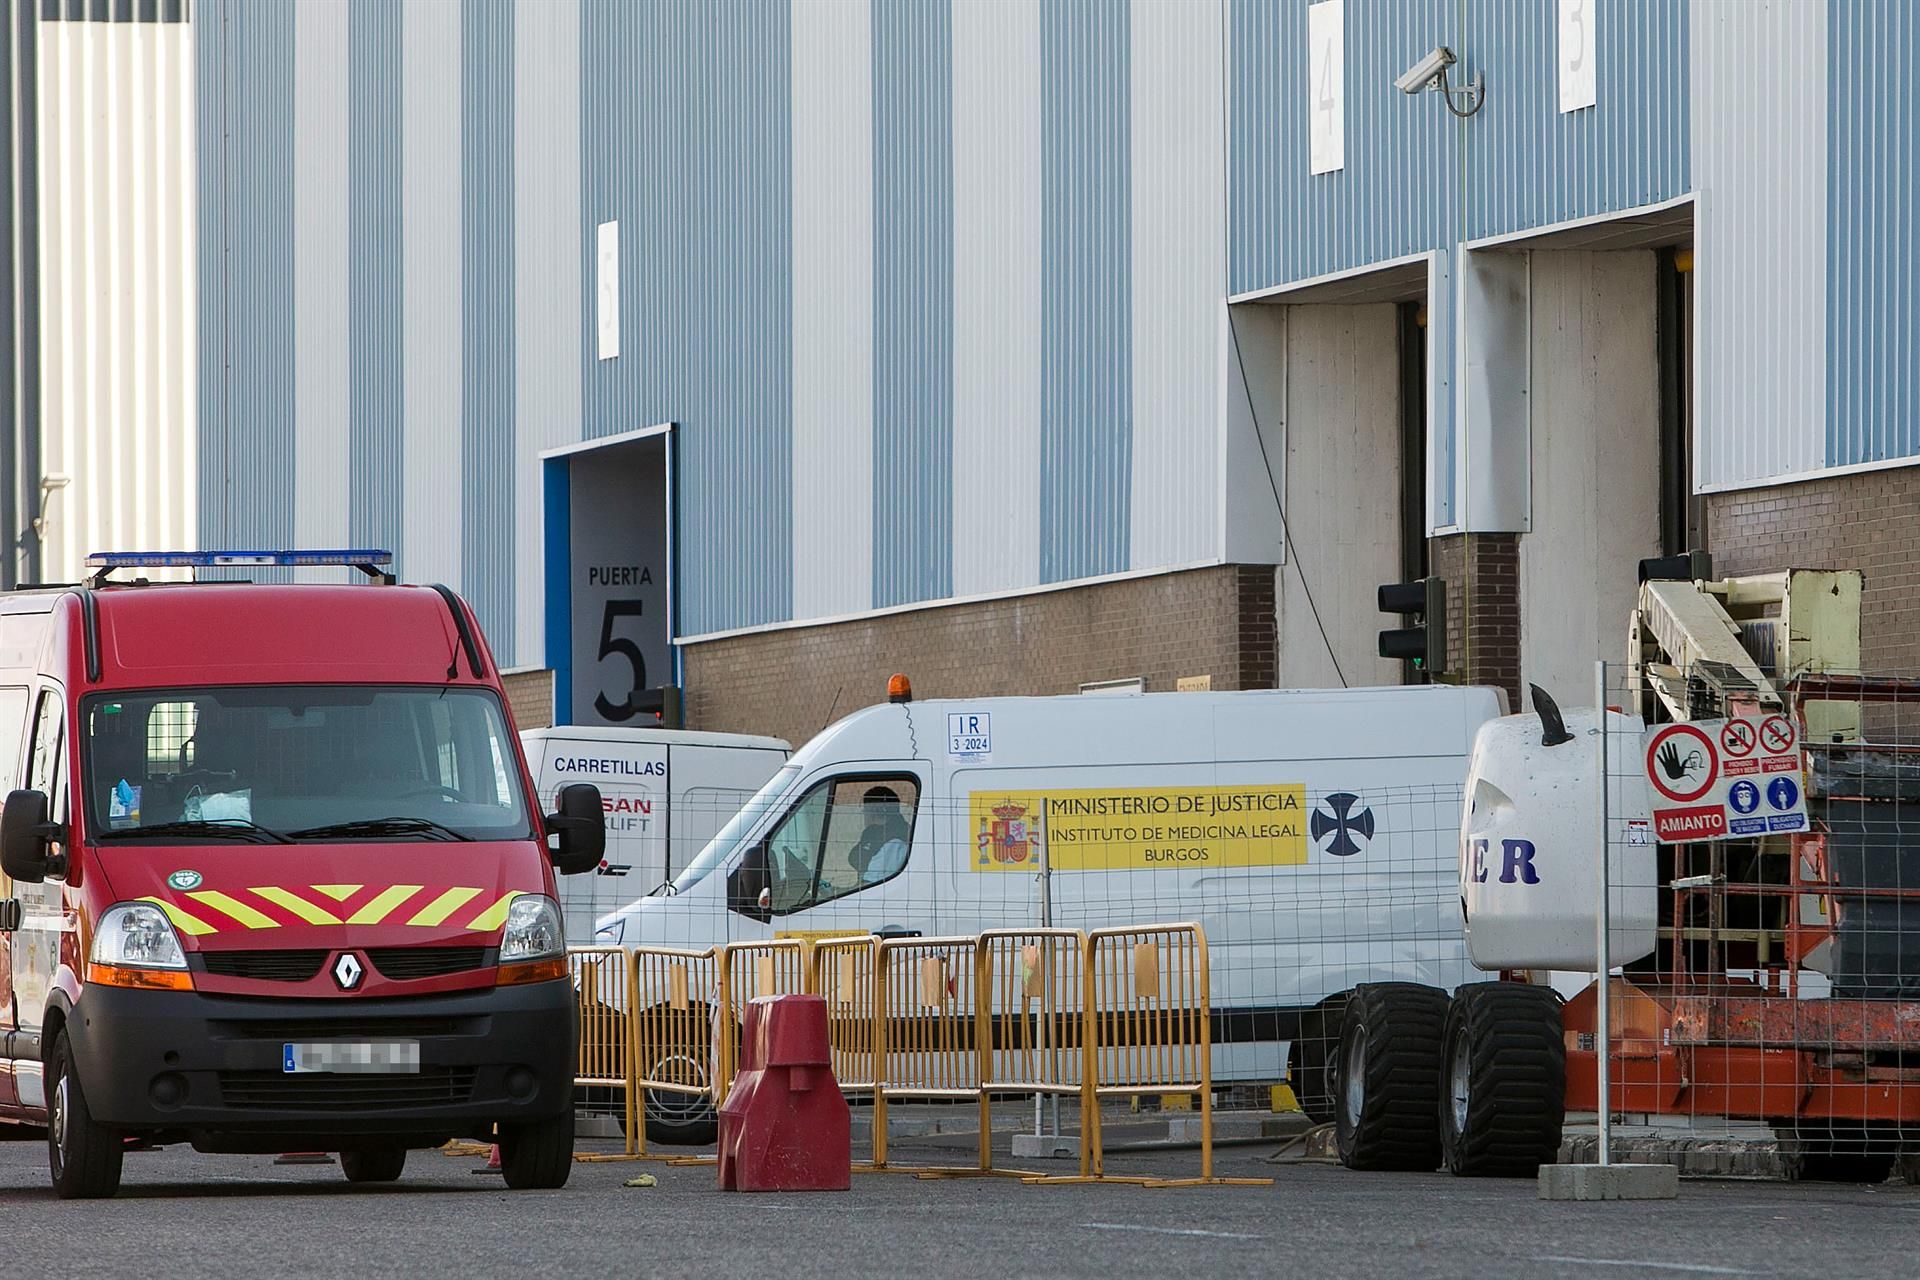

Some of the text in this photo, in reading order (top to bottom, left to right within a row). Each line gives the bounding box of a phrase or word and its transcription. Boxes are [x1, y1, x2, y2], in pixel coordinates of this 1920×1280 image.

[1318, 37, 1335, 136] 4
[589, 567, 653, 586] PUERTA
[594, 600, 646, 723] 5
[554, 757, 665, 776] CARRETILLAS
[1051, 793, 1299, 817] MINISTERIO DE JUSTICIA
[1051, 823, 1300, 842] INSTITUTO DE MEDICINA LEGAL
[1660, 814, 1722, 832] AMIANTO
[1145, 848, 1209, 862] BURGOS
[1470, 839, 1541, 884] ER
